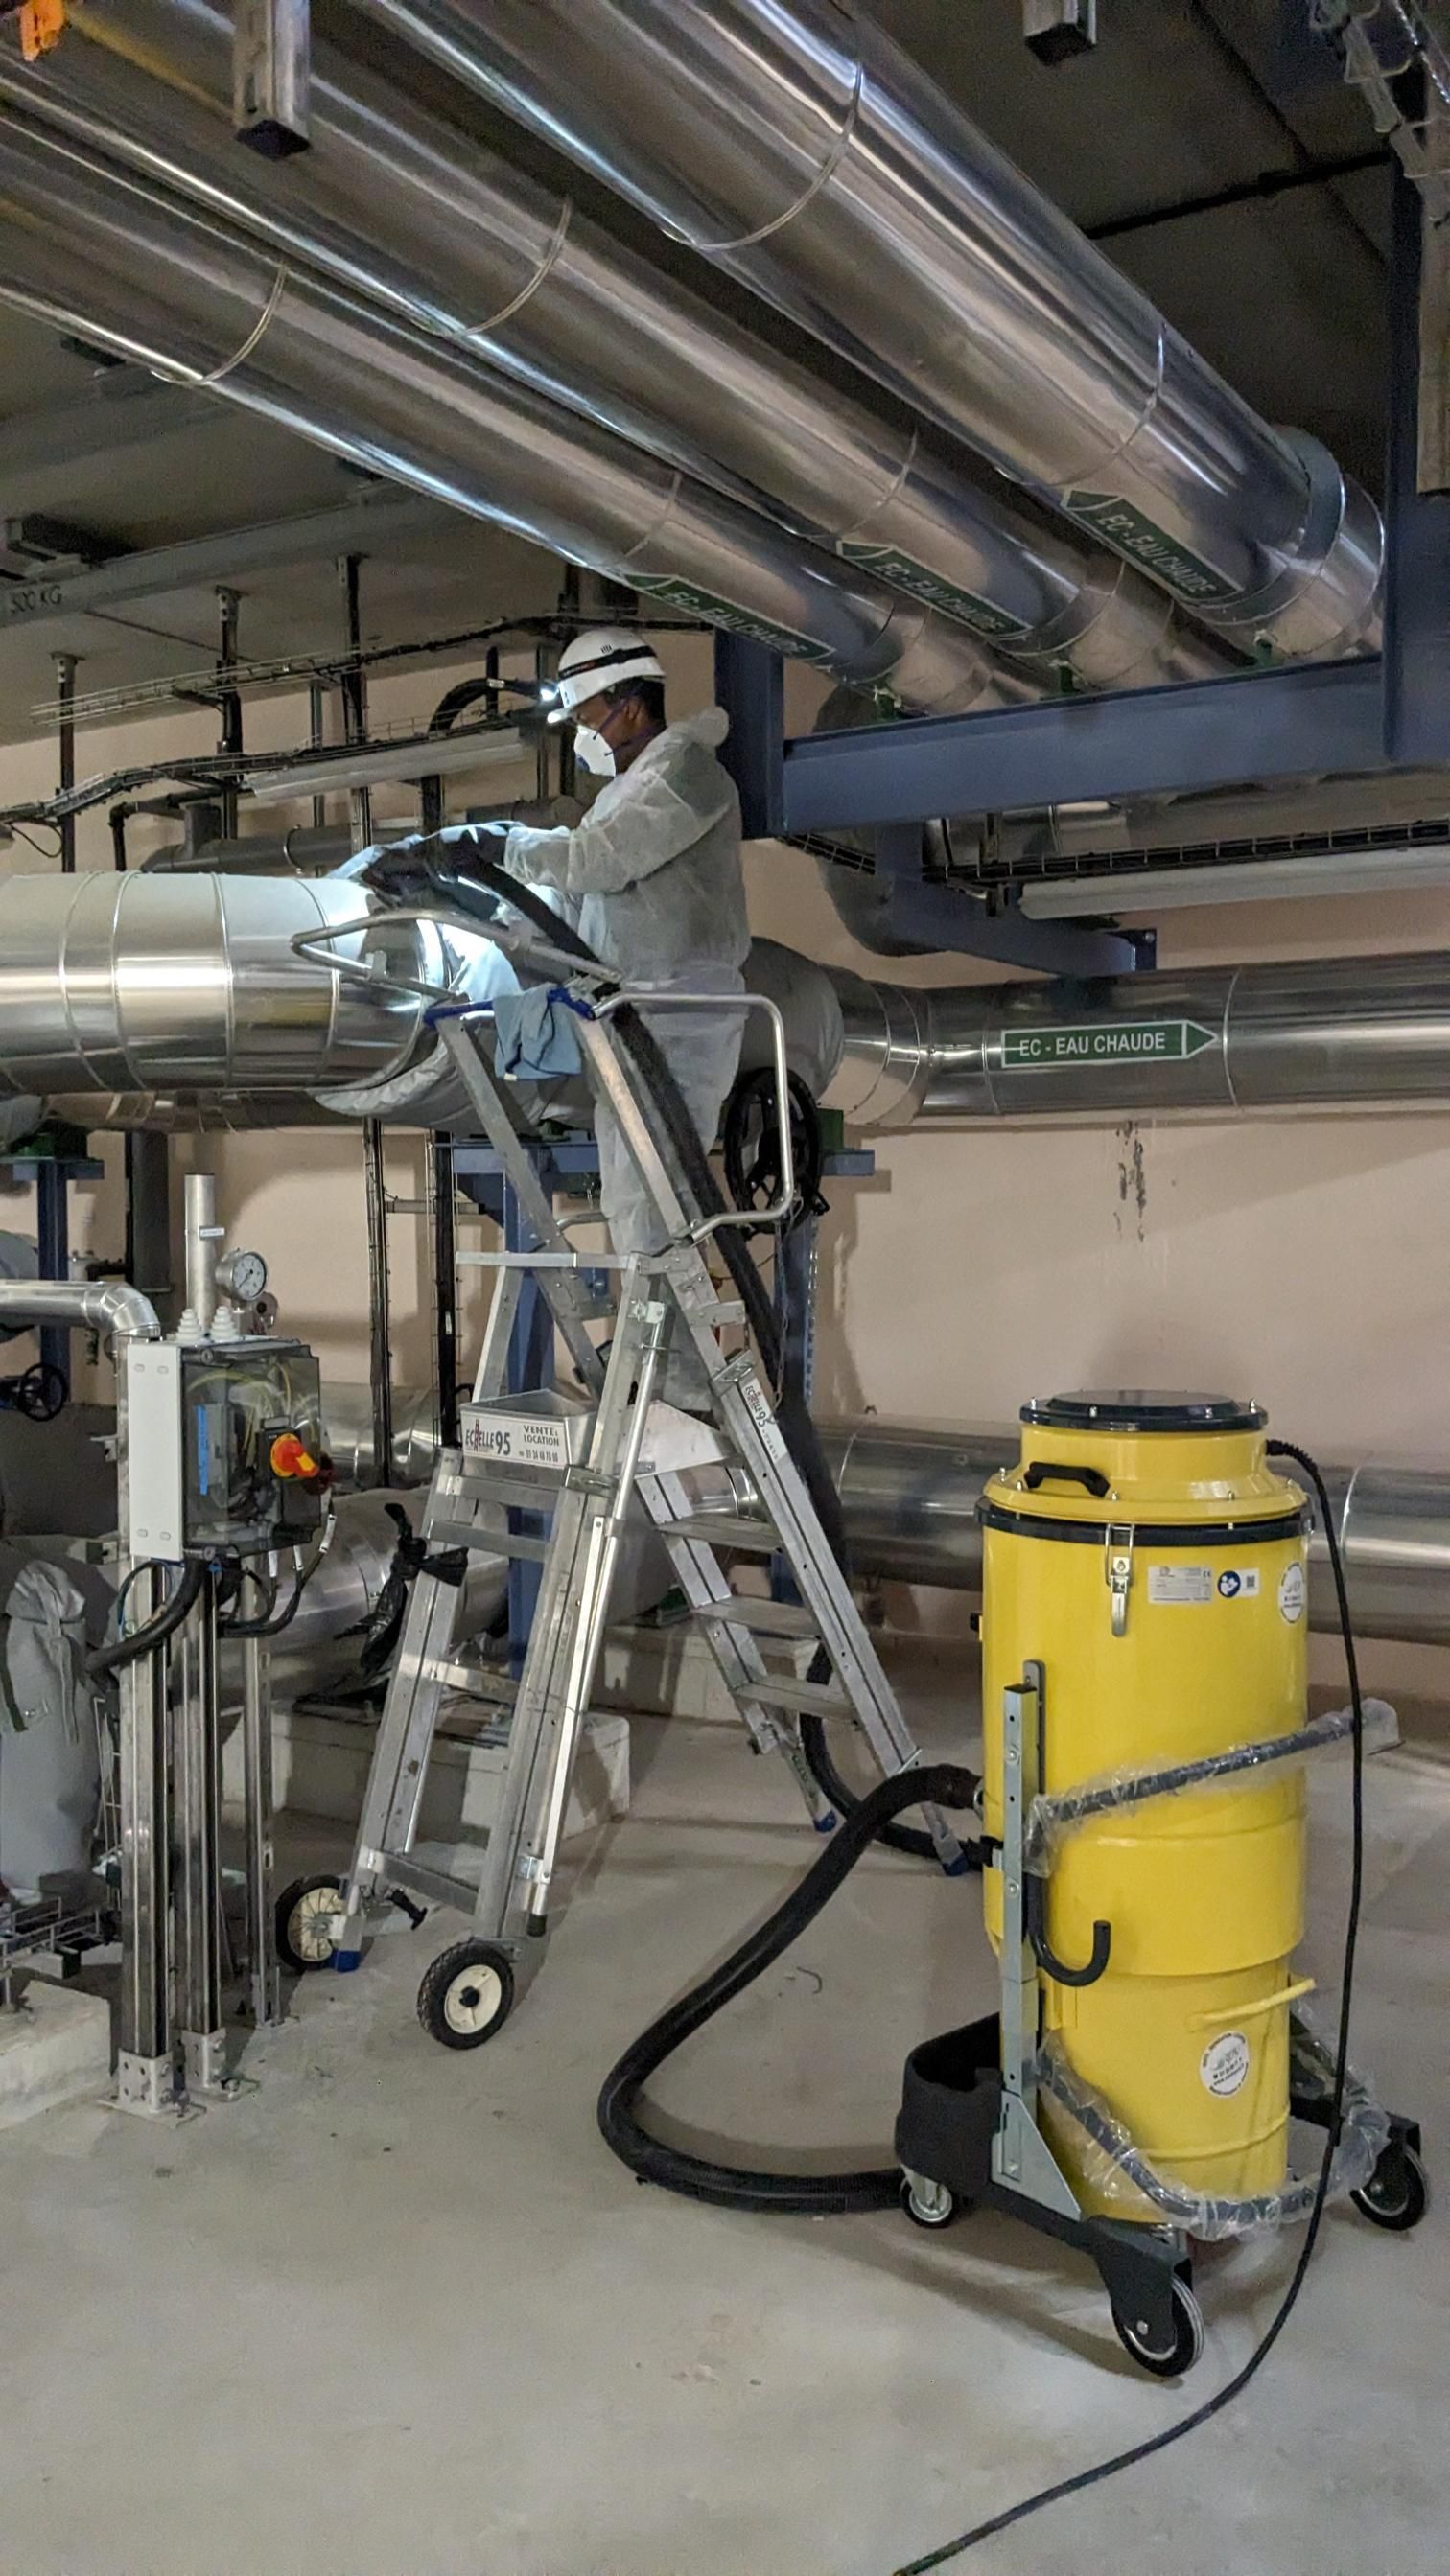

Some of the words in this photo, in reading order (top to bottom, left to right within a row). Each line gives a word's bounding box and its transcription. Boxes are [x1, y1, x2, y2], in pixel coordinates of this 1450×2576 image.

[1096, 514, 1134, 531] EC
[1124, 535, 1169, 558] EAU
[874, 562, 910, 577] EC
[664, 591, 699, 608] EC
[1019, 1039, 1041, 1056] EC
[1055, 1036, 1089, 1055] EAU
[1093, 1033, 1166, 1053] CHAUDE
[524, 1425, 554, 1436] VENTE
[524, 1434, 559, 1447] LOCATION
